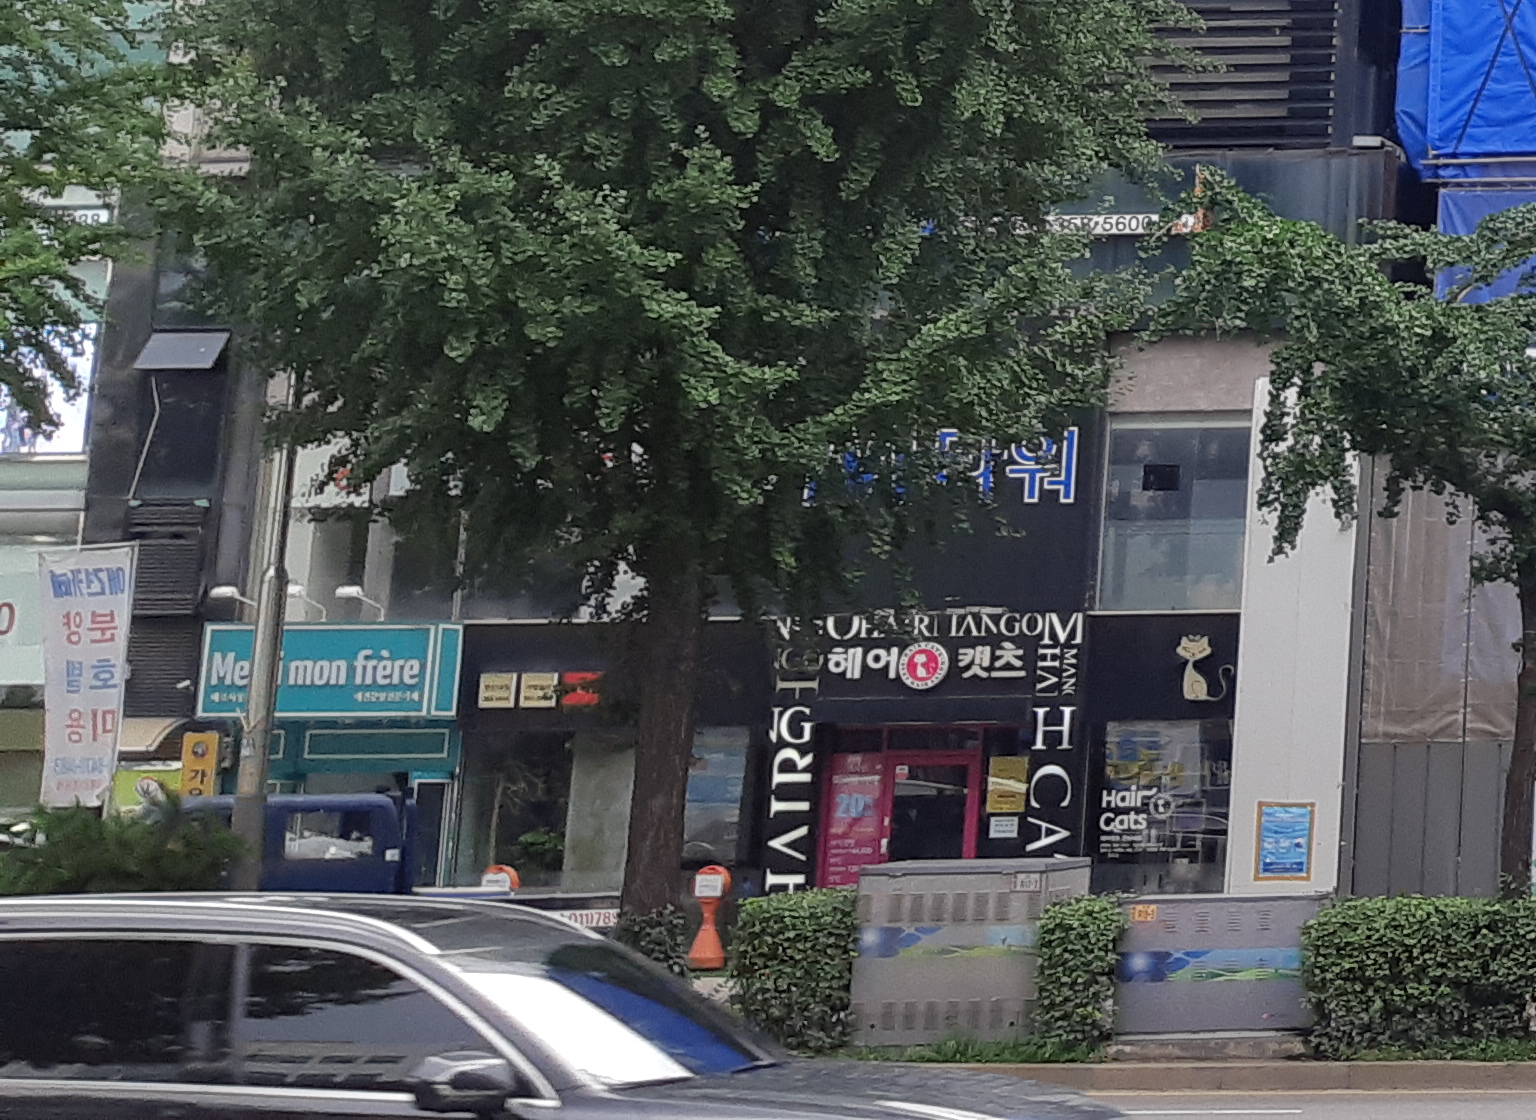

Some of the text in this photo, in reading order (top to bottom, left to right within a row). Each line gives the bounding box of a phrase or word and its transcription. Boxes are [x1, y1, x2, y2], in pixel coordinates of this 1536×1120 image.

[210, 648, 421, 687] Mei mon frère
[826, 641, 1027, 680] 헤어 캣츠
[1101, 784, 1158, 809] Hair
[1099, 811, 1148, 832] Cats
